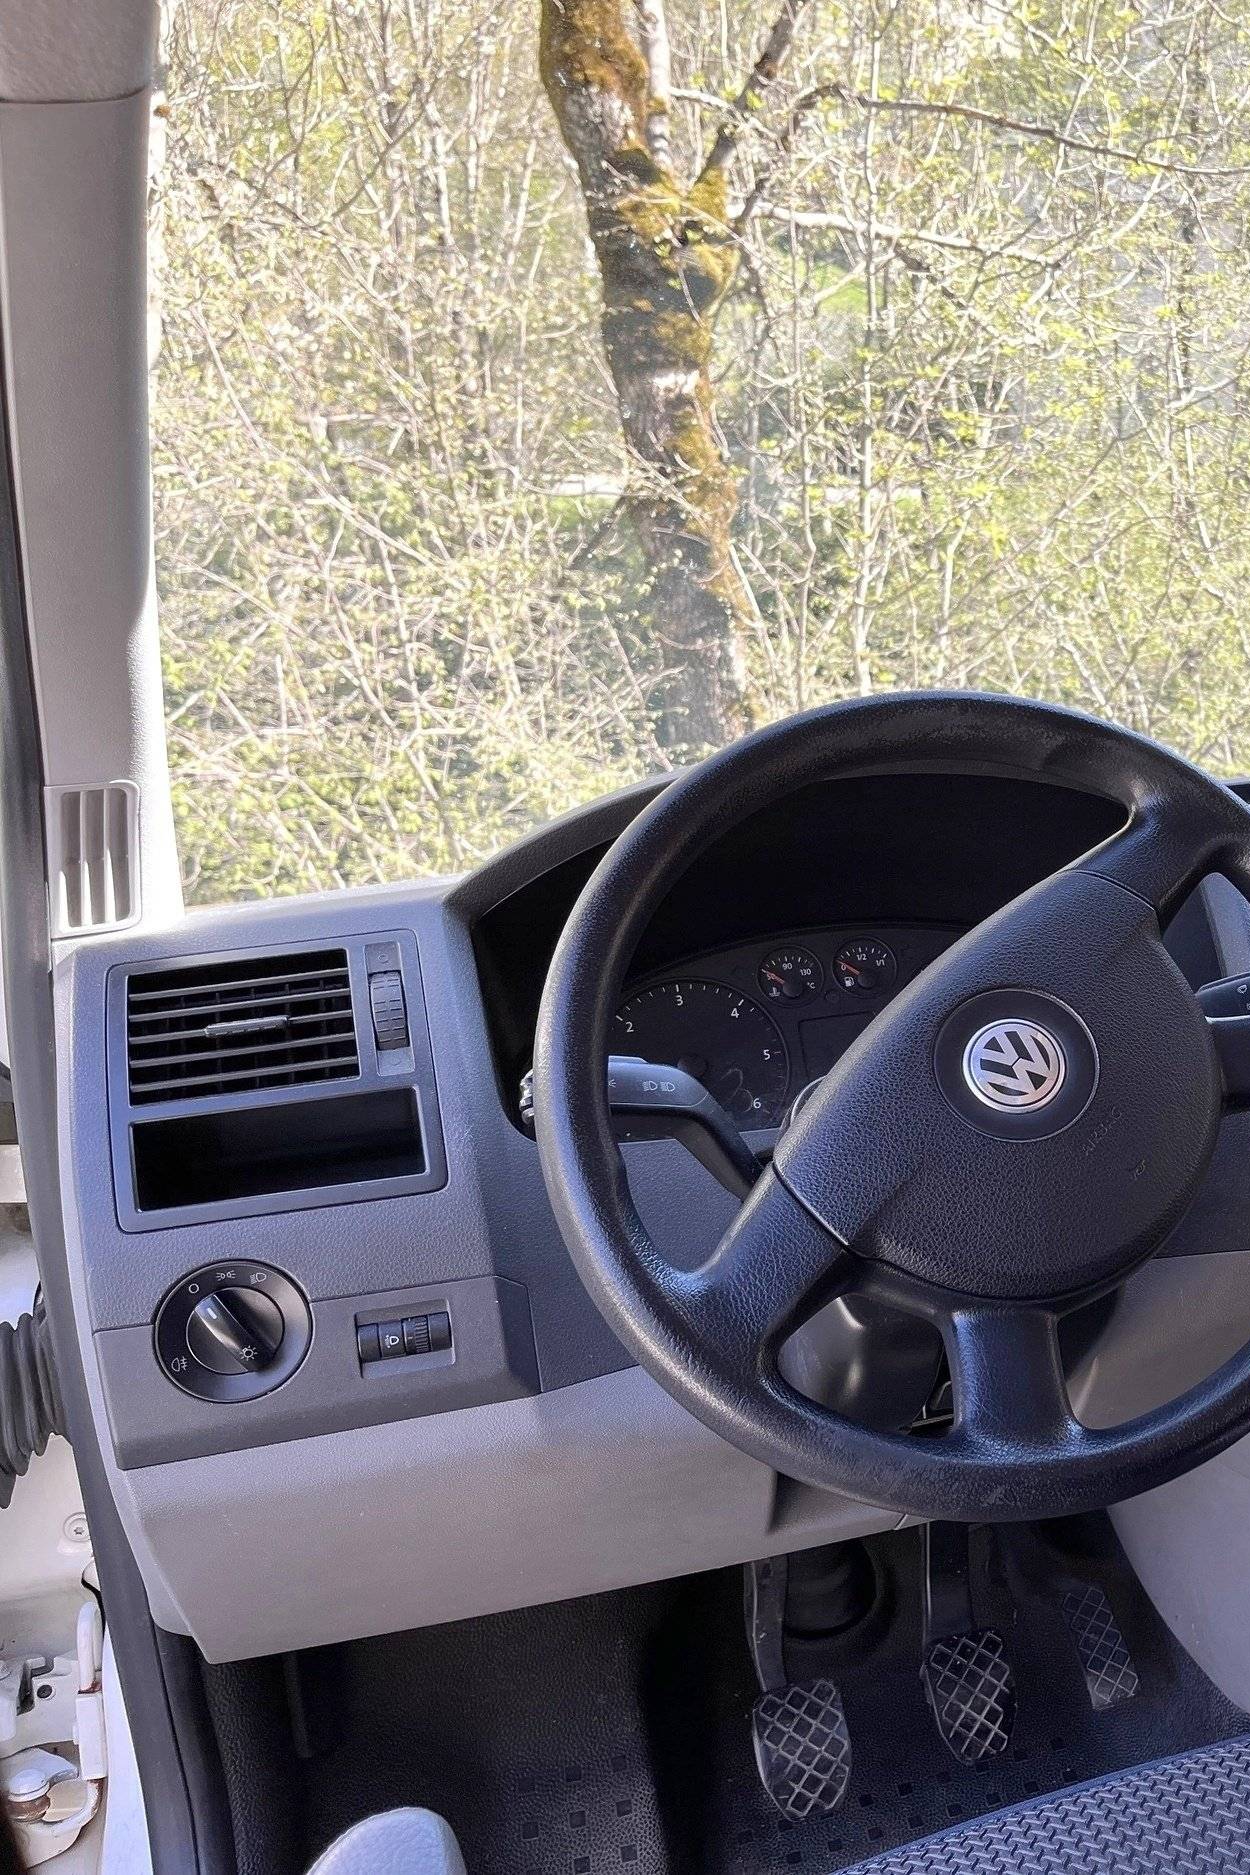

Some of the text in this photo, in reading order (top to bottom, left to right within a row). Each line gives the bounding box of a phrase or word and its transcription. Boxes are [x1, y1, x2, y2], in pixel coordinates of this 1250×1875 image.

[674, 994, 684, 1006] 3
[730, 1007, 740, 1019] 4
[625, 1021, 635, 1033] 2
[763, 1049, 771, 1060] 5
[752, 1098, 762, 1109] 6
